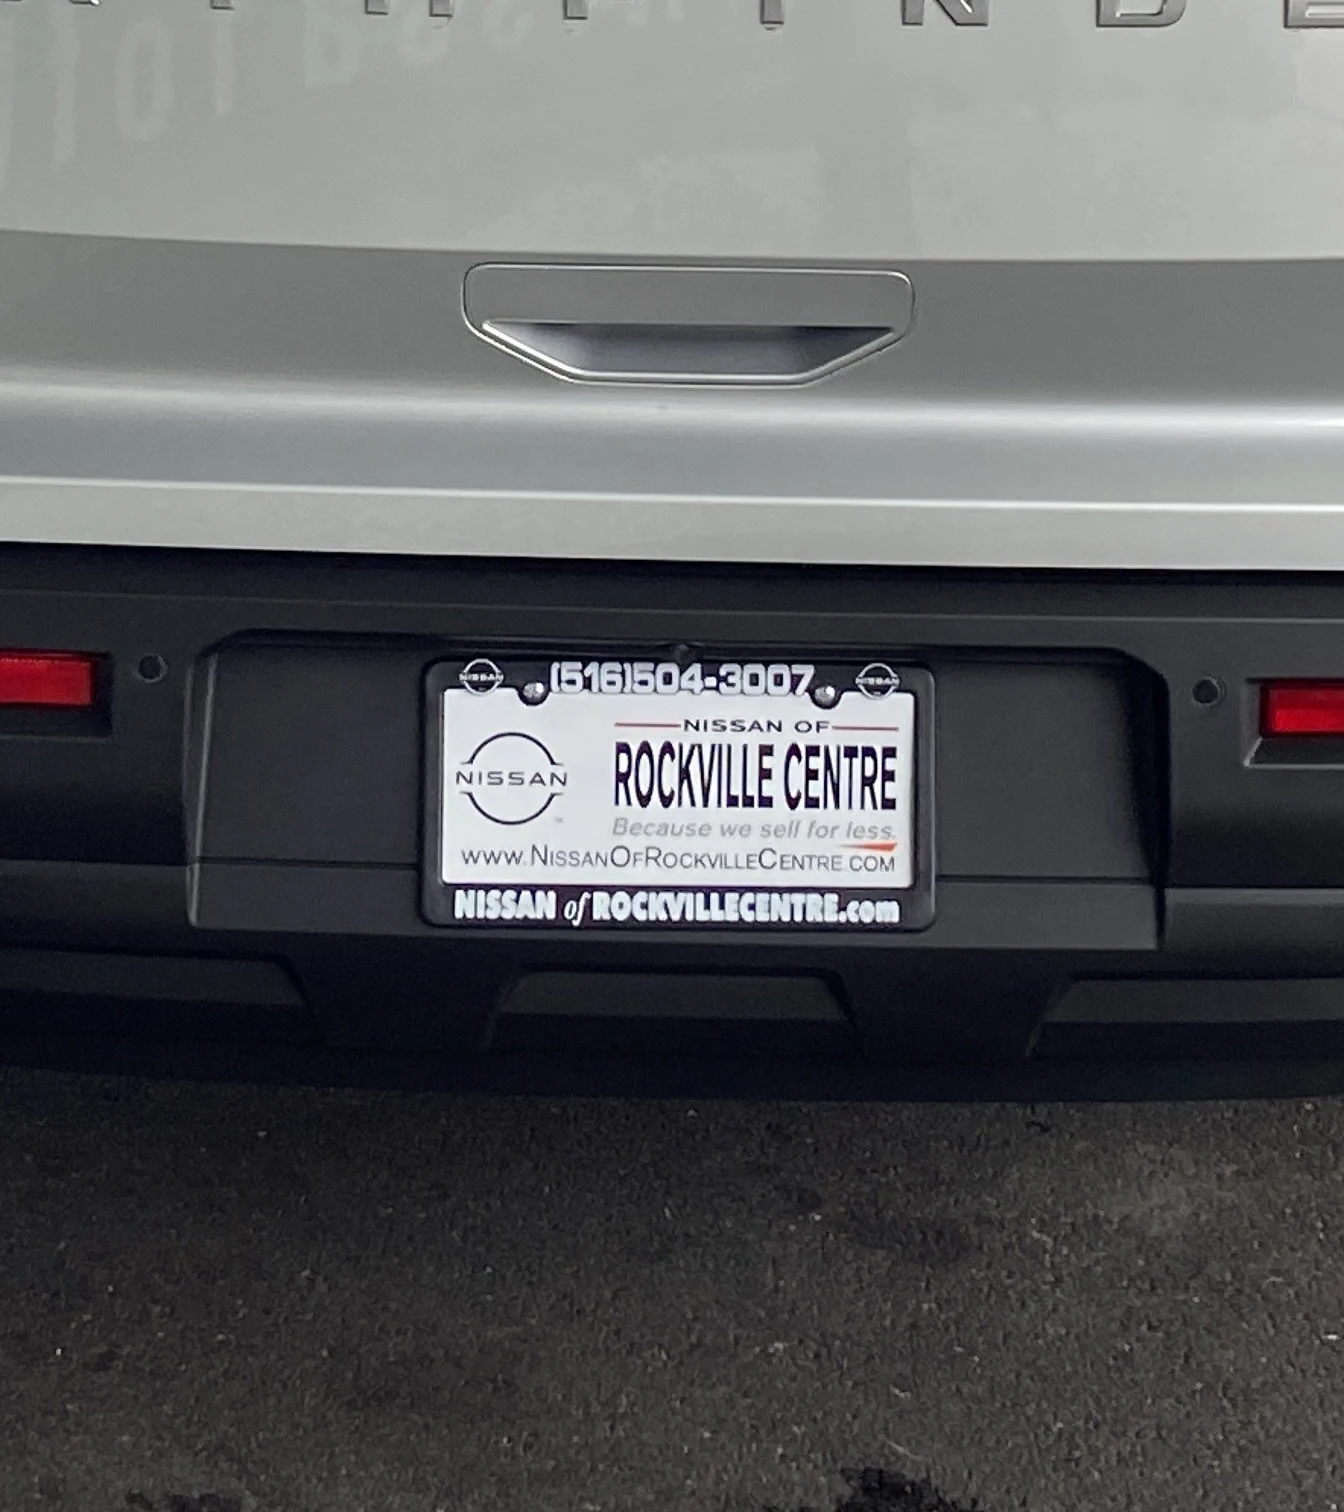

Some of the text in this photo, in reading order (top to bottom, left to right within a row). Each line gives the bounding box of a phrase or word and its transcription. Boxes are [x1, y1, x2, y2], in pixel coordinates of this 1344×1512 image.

[549, 660, 816, 696] (516)504-3007
[683, 718, 831, 735] NISSAN OF
[455, 770, 568, 788] NISSAN
[614, 740, 898, 811] ROCKVILLE CENTRE
[612, 817, 898, 841] Because we sell for less.
[454, 889, 901, 927] NISSAN of ROCKVILLECENTRE.com
